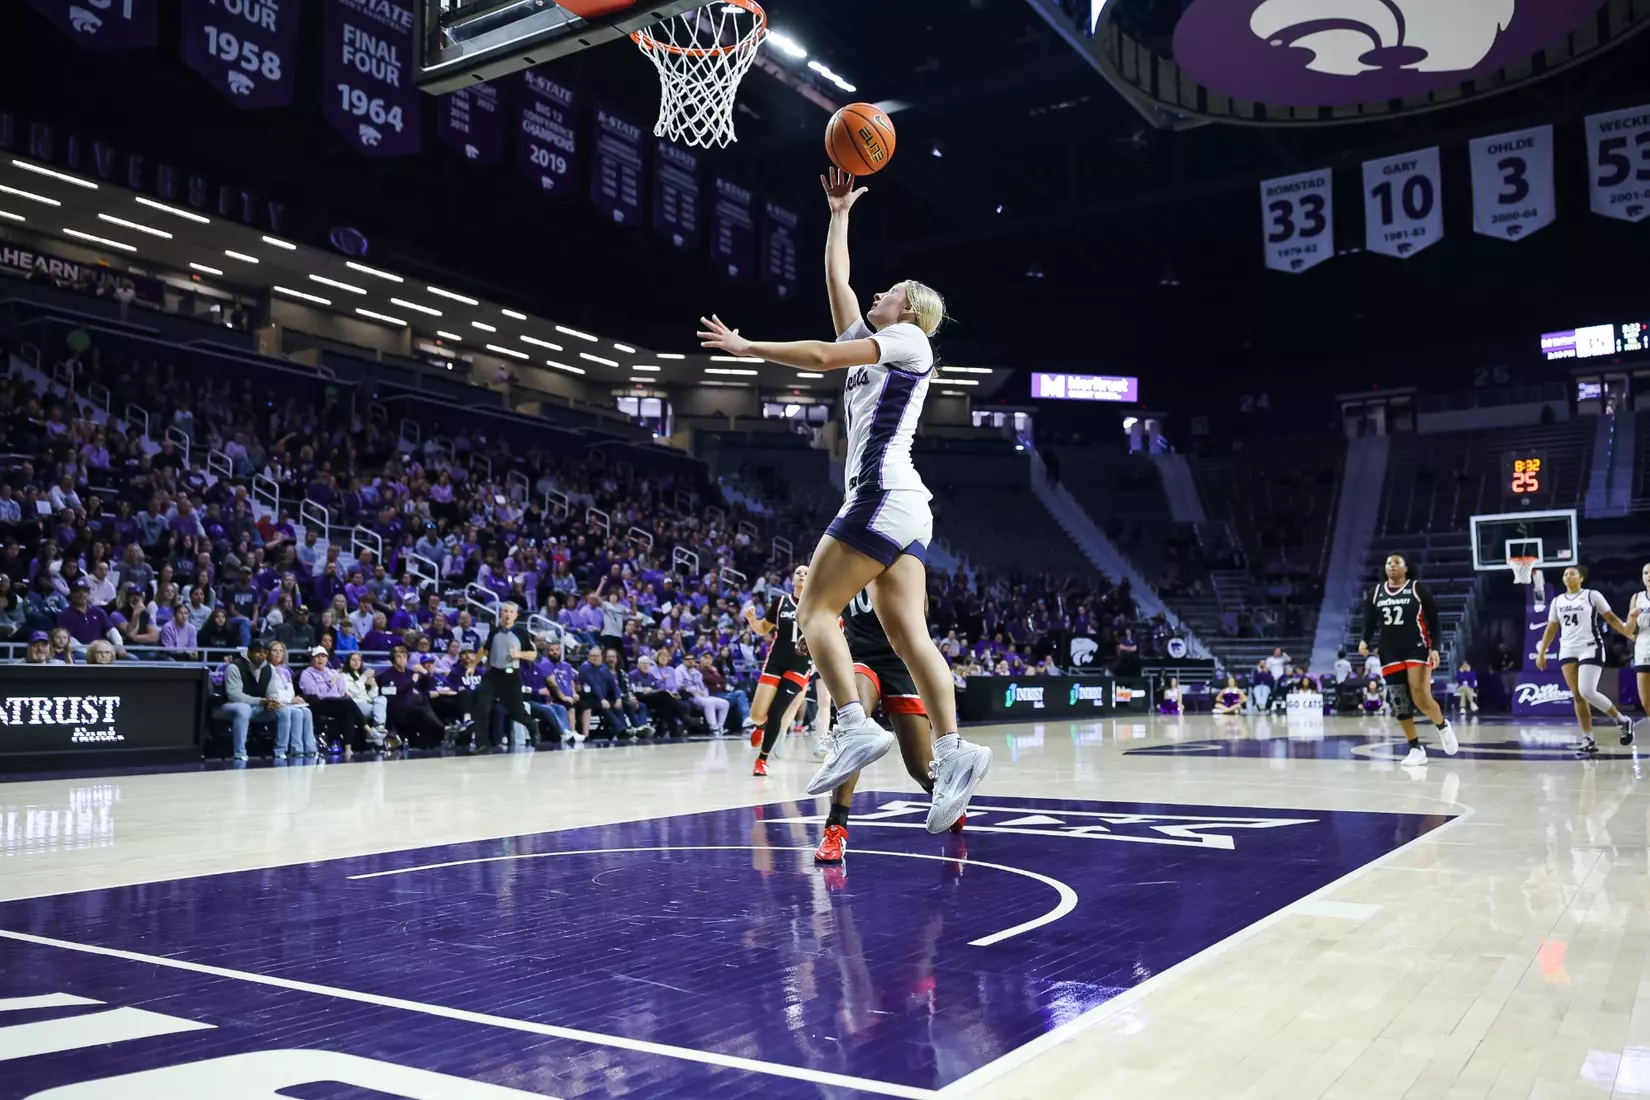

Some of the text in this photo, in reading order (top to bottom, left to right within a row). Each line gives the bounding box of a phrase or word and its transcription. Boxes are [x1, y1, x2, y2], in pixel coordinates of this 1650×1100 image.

[211, 0, 277, 32] OUR
[204, 25, 283, 81] 1958
[343, 24, 402, 68] FINAL
[343, 44, 400, 88] FOUR
[525, 70, 573, 105] K-STATE
[338, 84, 404, 133] 1964
[552, 109, 564, 124] 12
[1599, 114, 1650, 133] WECKE
[522, 120, 576, 153] CHAMPIONS
[858, 126, 884, 163] ELITE
[1487, 137, 1535, 155] OHLDE
[530, 144, 567, 174] 2019
[1383, 160, 1418, 175] GARY
[1266, 178, 1325, 197] ROMSTAD
[1497, 156, 1529, 204] 3
[1371, 174, 1434, 225] 10
[1268, 194, 1326, 243] 33
[1491, 208, 1538, 223] 2000-04
[0, 247, 79, 281] HEARN
[846, 366, 871, 392] cats
[1514, 458, 1540, 472] 8:32
[1512, 471, 1539, 493] 25
[1382, 606, 1405, 625] 32
[1563, 614, 1579, 626] 24
